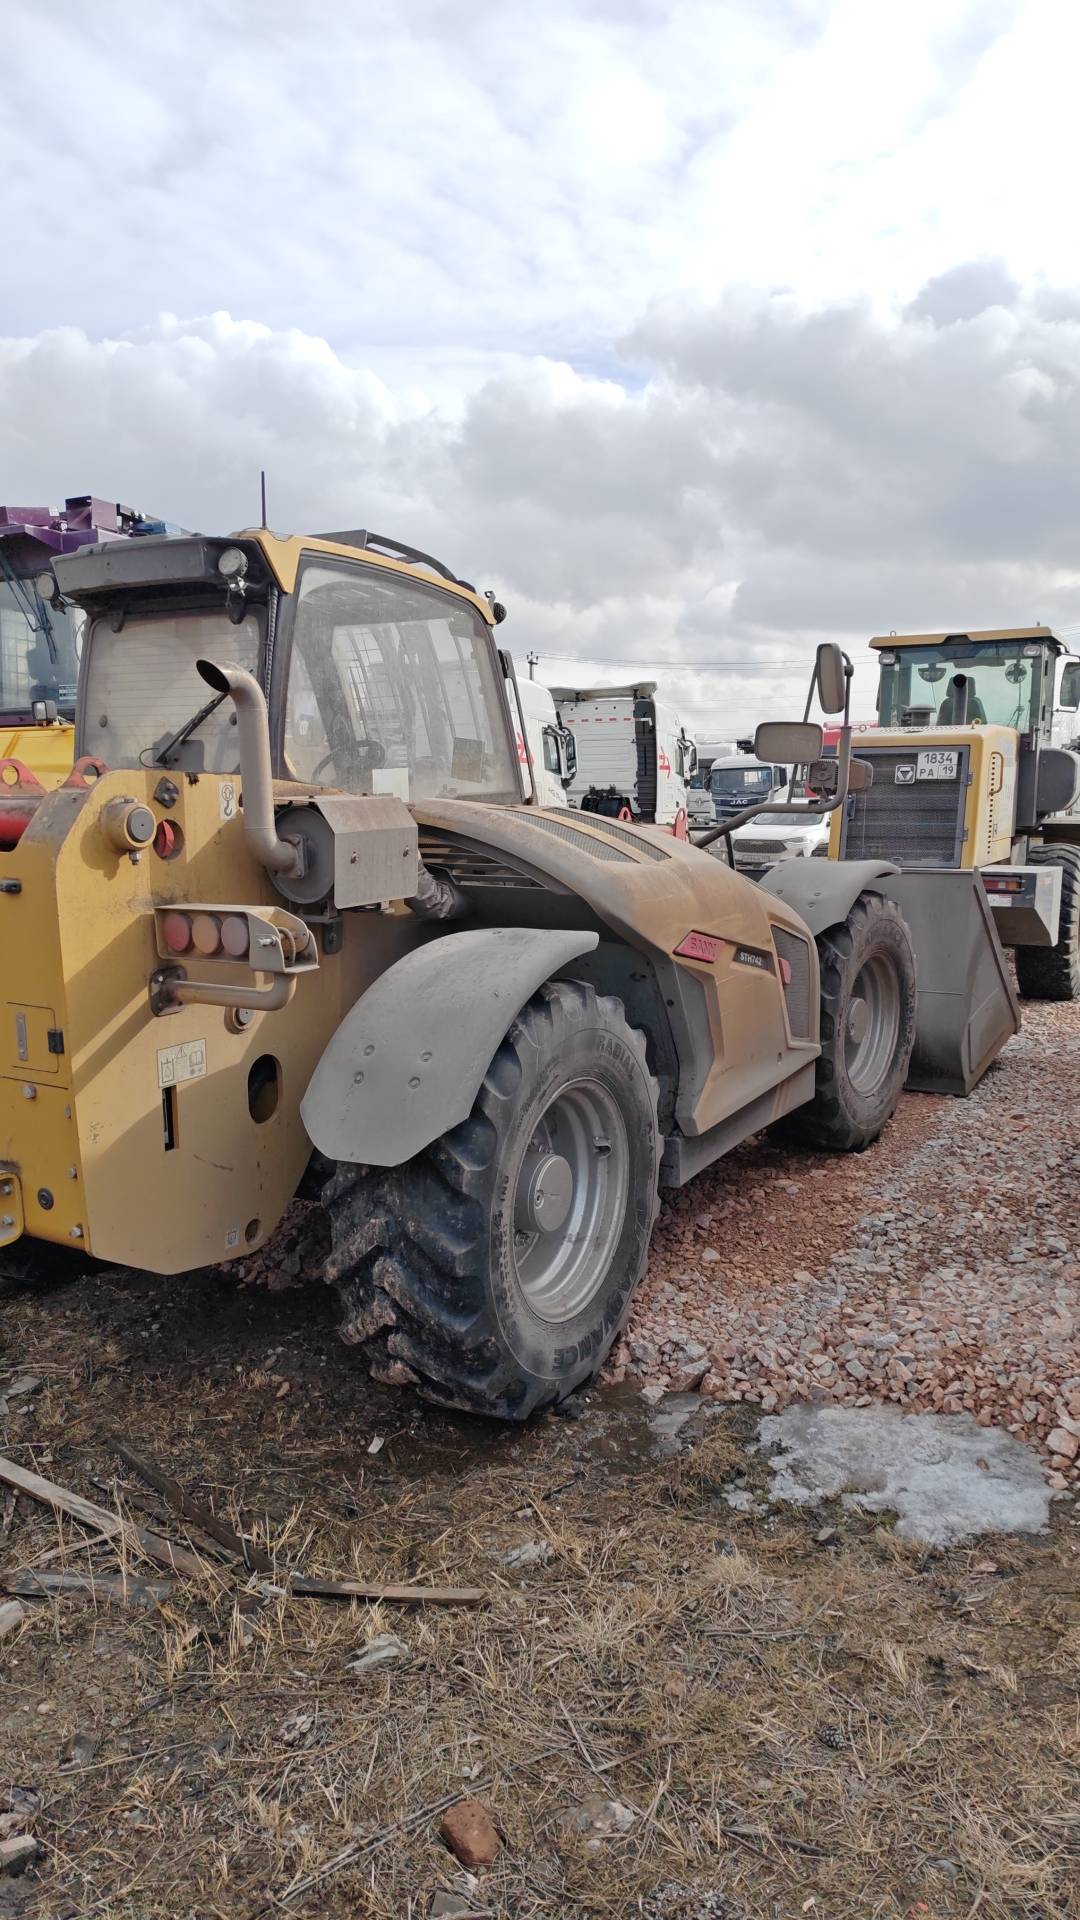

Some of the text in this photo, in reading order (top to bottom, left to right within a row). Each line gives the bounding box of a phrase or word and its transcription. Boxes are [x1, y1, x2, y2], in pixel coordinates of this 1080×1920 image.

[924, 752, 953, 764] 1834
[942, 765, 954, 775] 19
[740, 951, 762, 966] STH742
[599, 1034, 636, 1080] RADIAL
